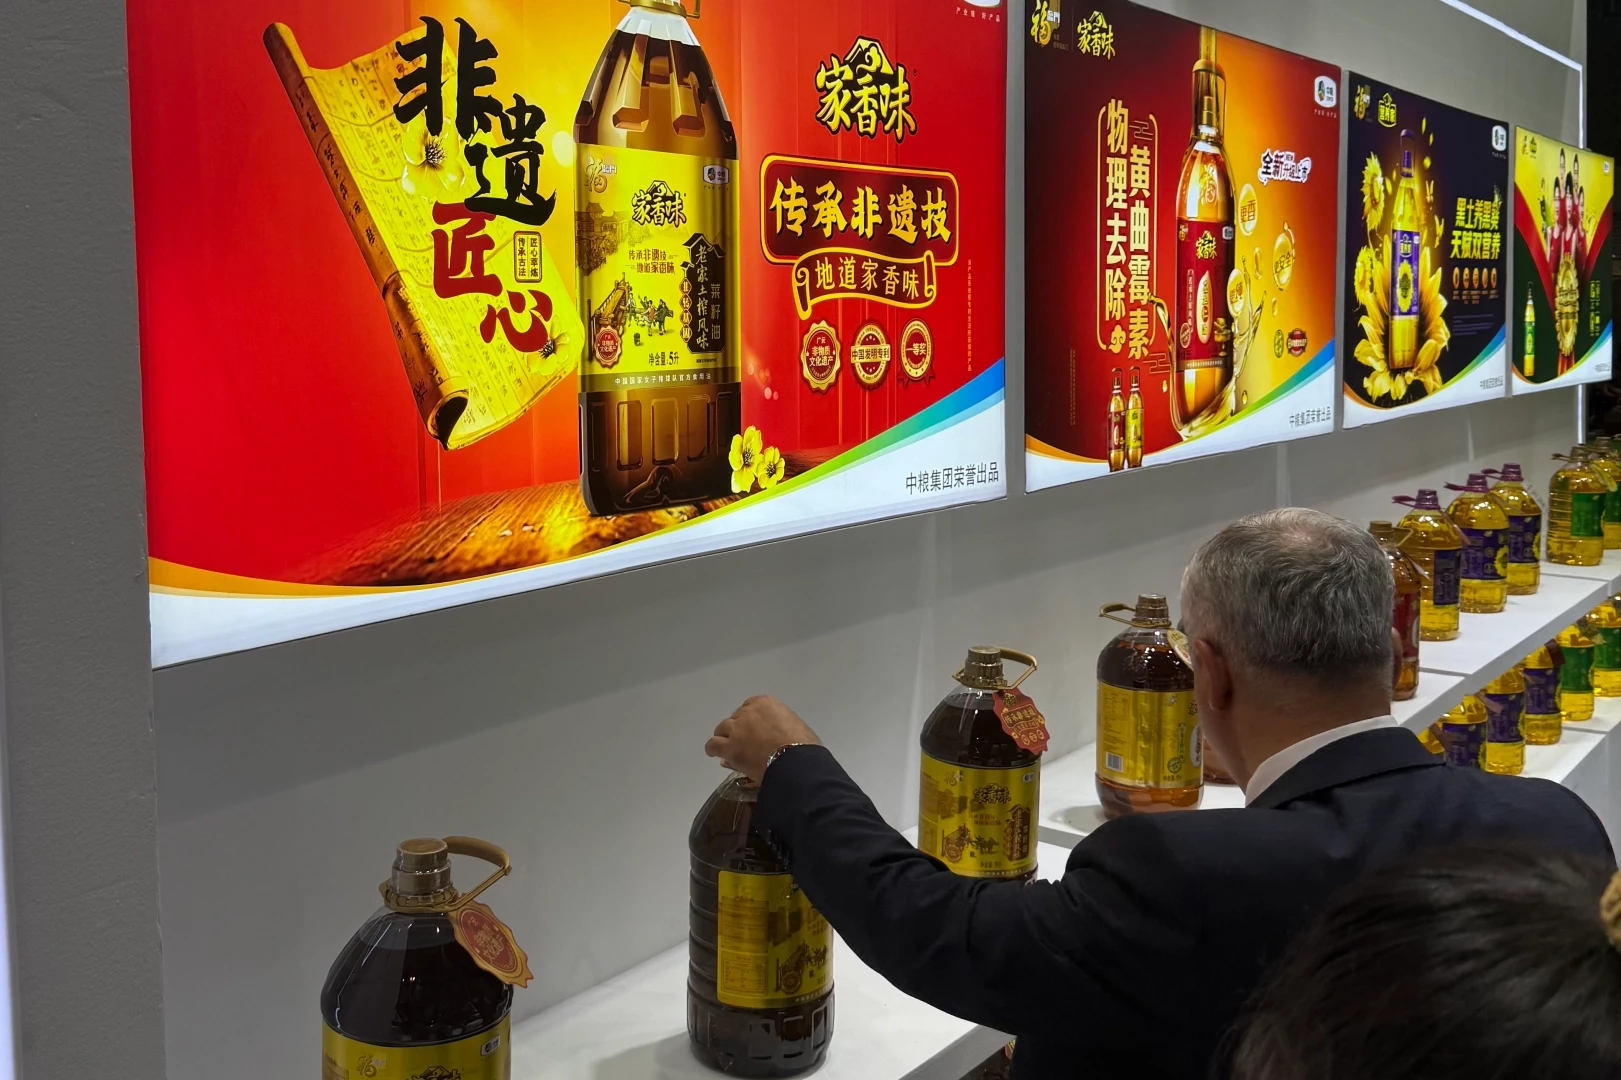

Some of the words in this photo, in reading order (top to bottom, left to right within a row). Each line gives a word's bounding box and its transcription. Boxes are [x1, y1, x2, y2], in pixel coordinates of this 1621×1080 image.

[1077, 10, 1116, 60] 家香味
[815, 35, 917, 144] 家香味
[393, 16, 557, 226] 非遗
[631, 179, 687, 228] 家香味
[769, 176, 952, 243] 传承非遗技
[1105, 98, 1129, 322] 物理去除
[432, 200, 553, 353] 匠心
[814, 256, 920, 300] 地道家香味
[1127, 143, 1151, 360] 黄曲霉素
[851, 347, 890, 361] 中国发明专利
[905, 342, 927, 356] 一等奖
[904, 460, 999, 495] 中粮集团荣誉出品
